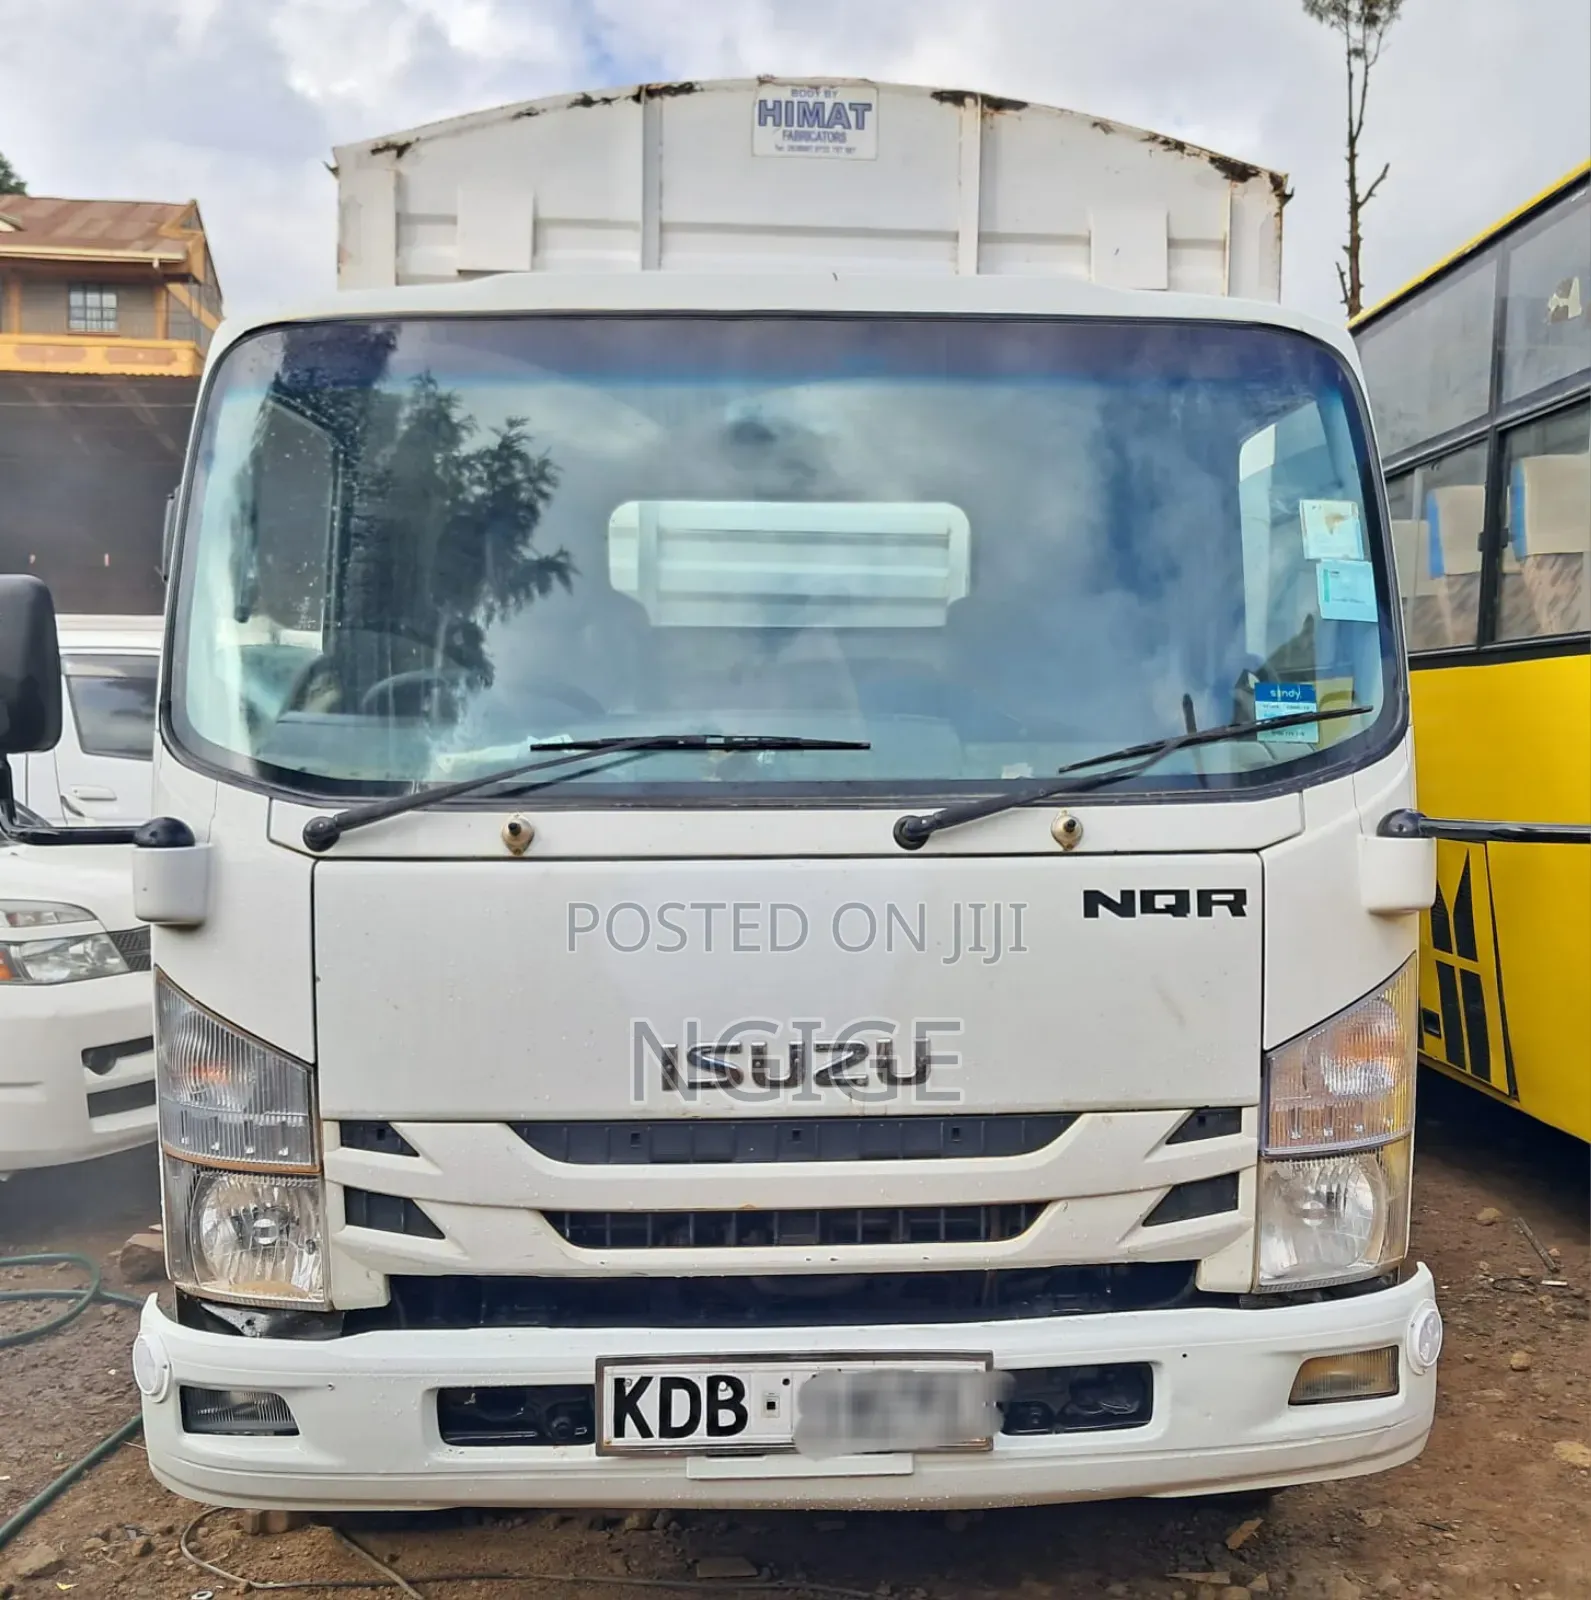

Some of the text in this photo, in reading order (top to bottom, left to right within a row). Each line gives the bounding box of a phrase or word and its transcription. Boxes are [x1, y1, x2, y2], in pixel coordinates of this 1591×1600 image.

[791, 88, 839, 98] BODY BY
[758, 99, 872, 130] HIMAT
[1083, 888, 1247, 918] NQR
[660, 1038, 932, 1092] ISUZU
[612, 1374, 749, 1440] KDB
